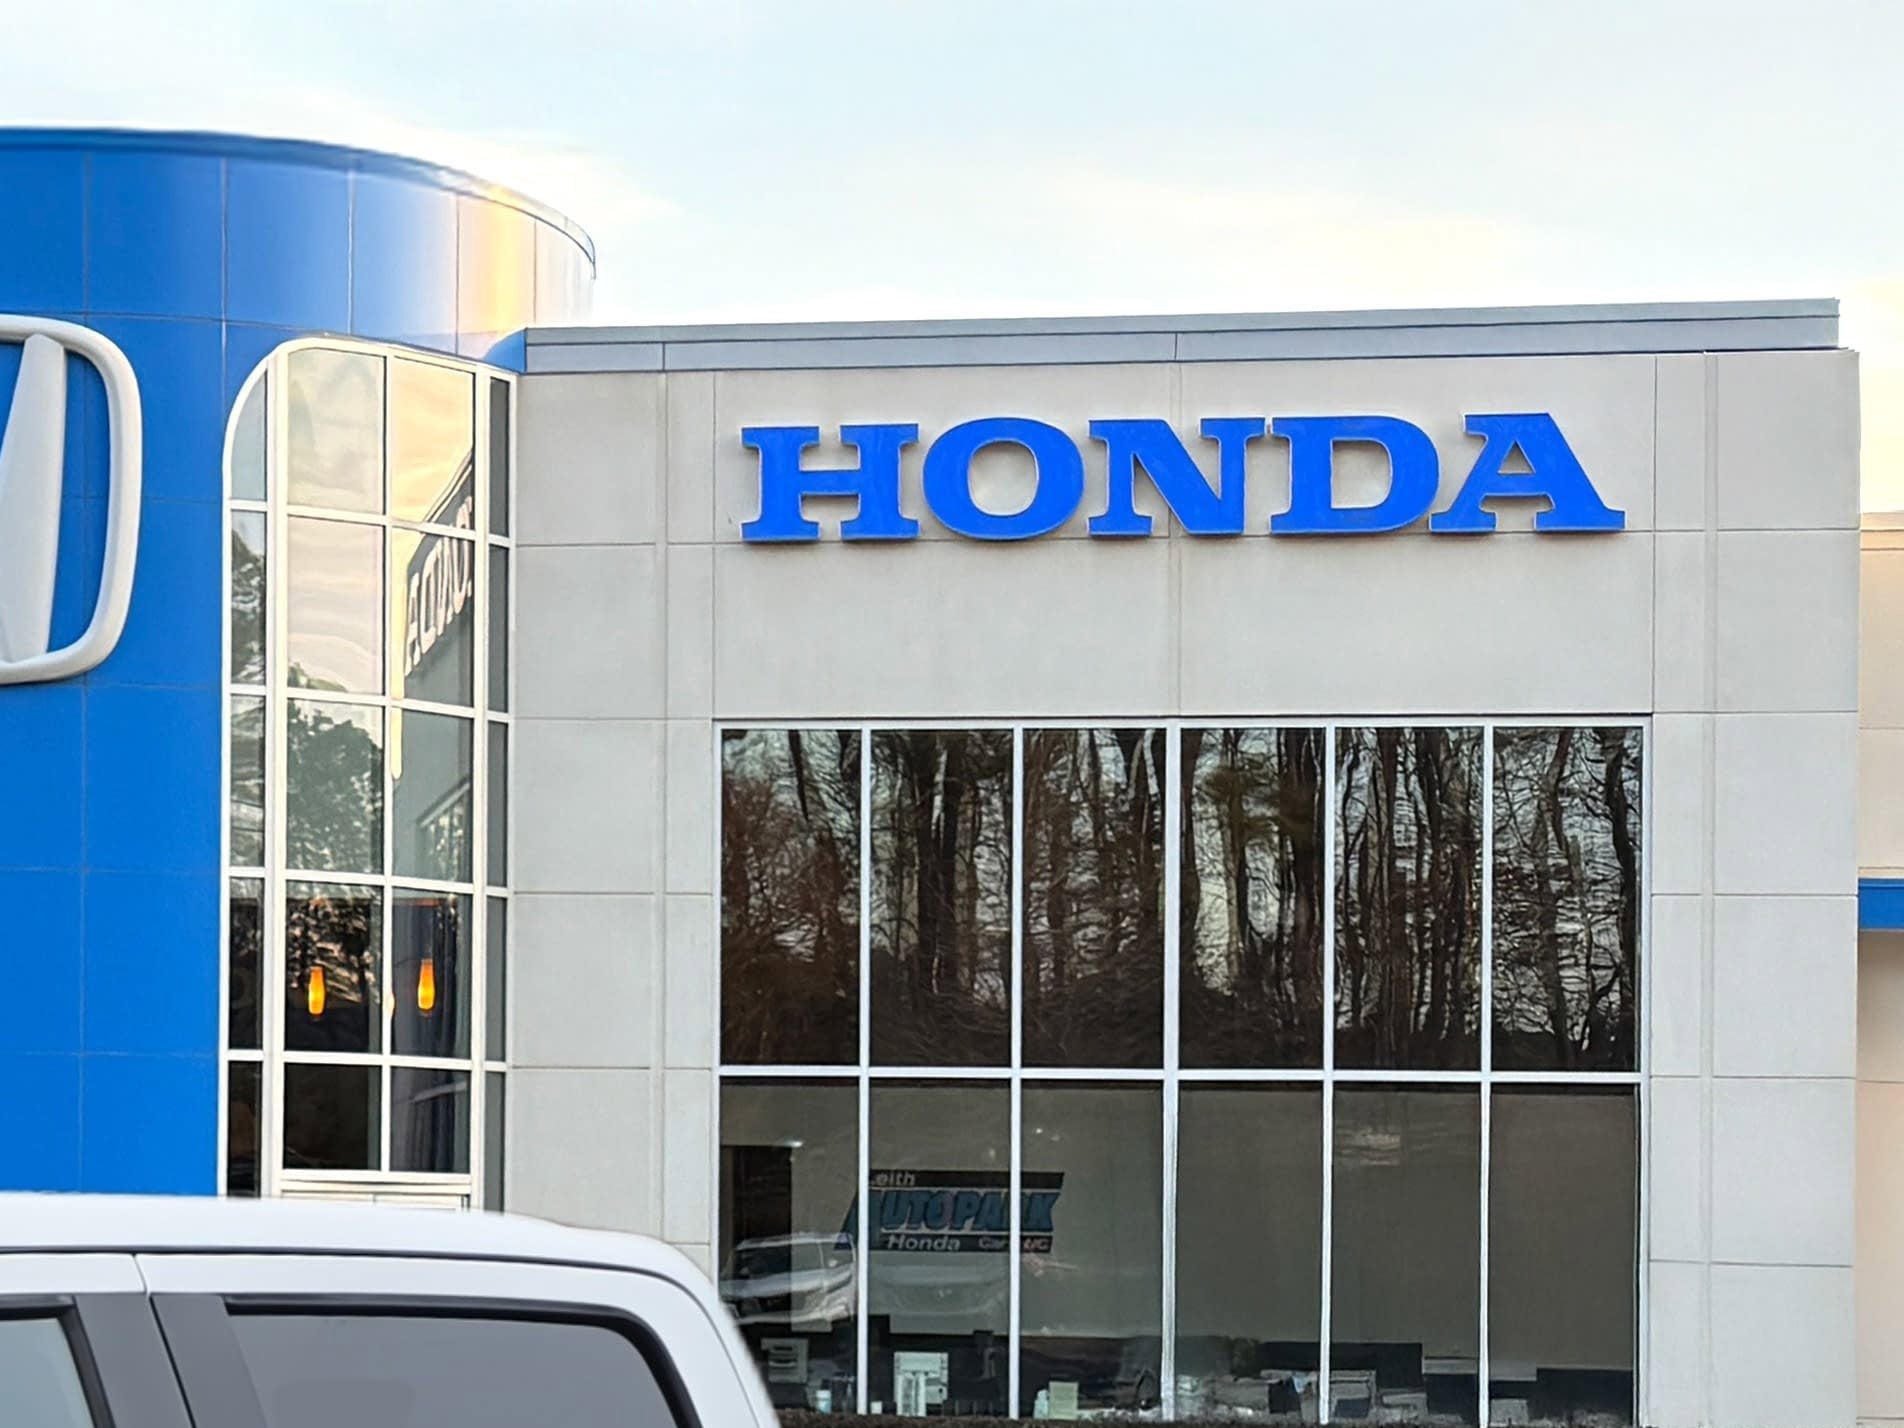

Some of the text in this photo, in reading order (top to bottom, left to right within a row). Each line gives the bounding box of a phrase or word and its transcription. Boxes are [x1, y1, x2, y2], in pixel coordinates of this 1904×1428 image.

[740, 411, 1626, 543] HONDA
[868, 1170, 916, 1187] eith
[887, 1234, 961, 1252] Honda
